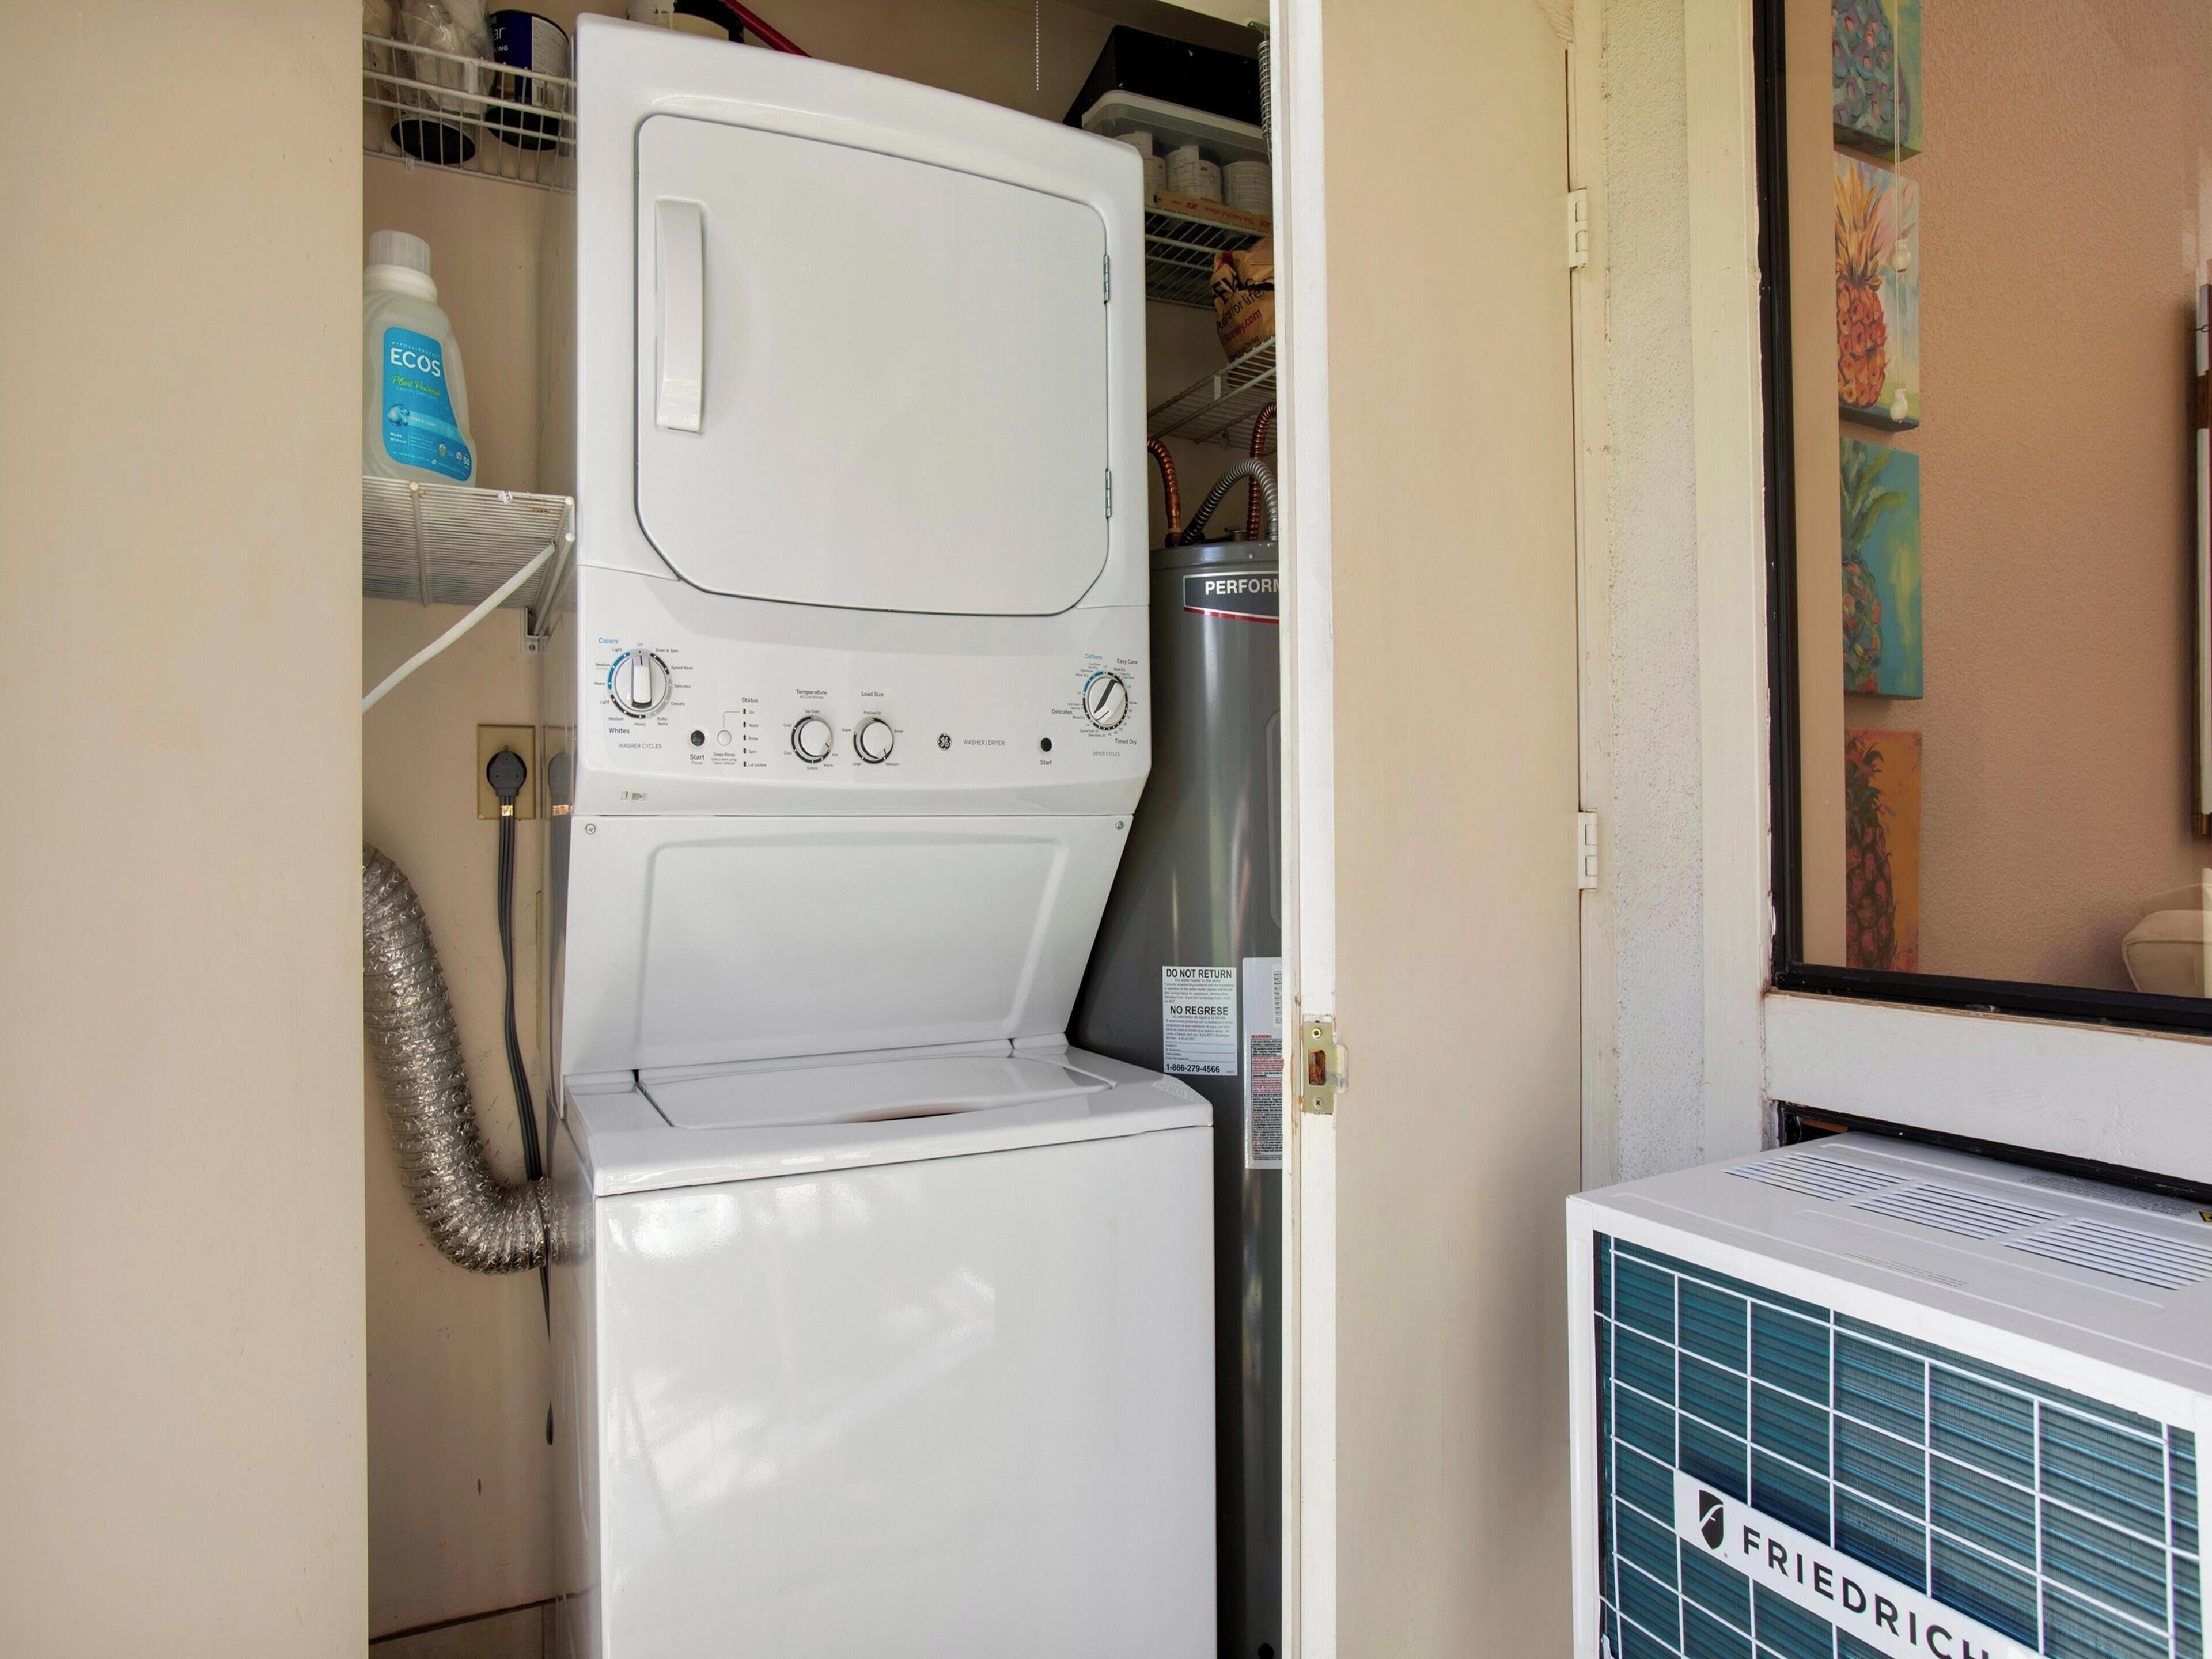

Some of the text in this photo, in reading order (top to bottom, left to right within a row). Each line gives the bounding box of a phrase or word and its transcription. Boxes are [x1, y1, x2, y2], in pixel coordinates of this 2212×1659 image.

[1221, 211, 1243, 222] helpful
[391, 347, 441, 377] ECOS
[392, 375, 440, 396] Plant Powered
[1166, 969, 1232, 978] DO NOT RETURN
[1171, 1006, 1229, 1015] NO REGRESE
[1166, 1063, 1220, 1073] 1-866-279-4566
